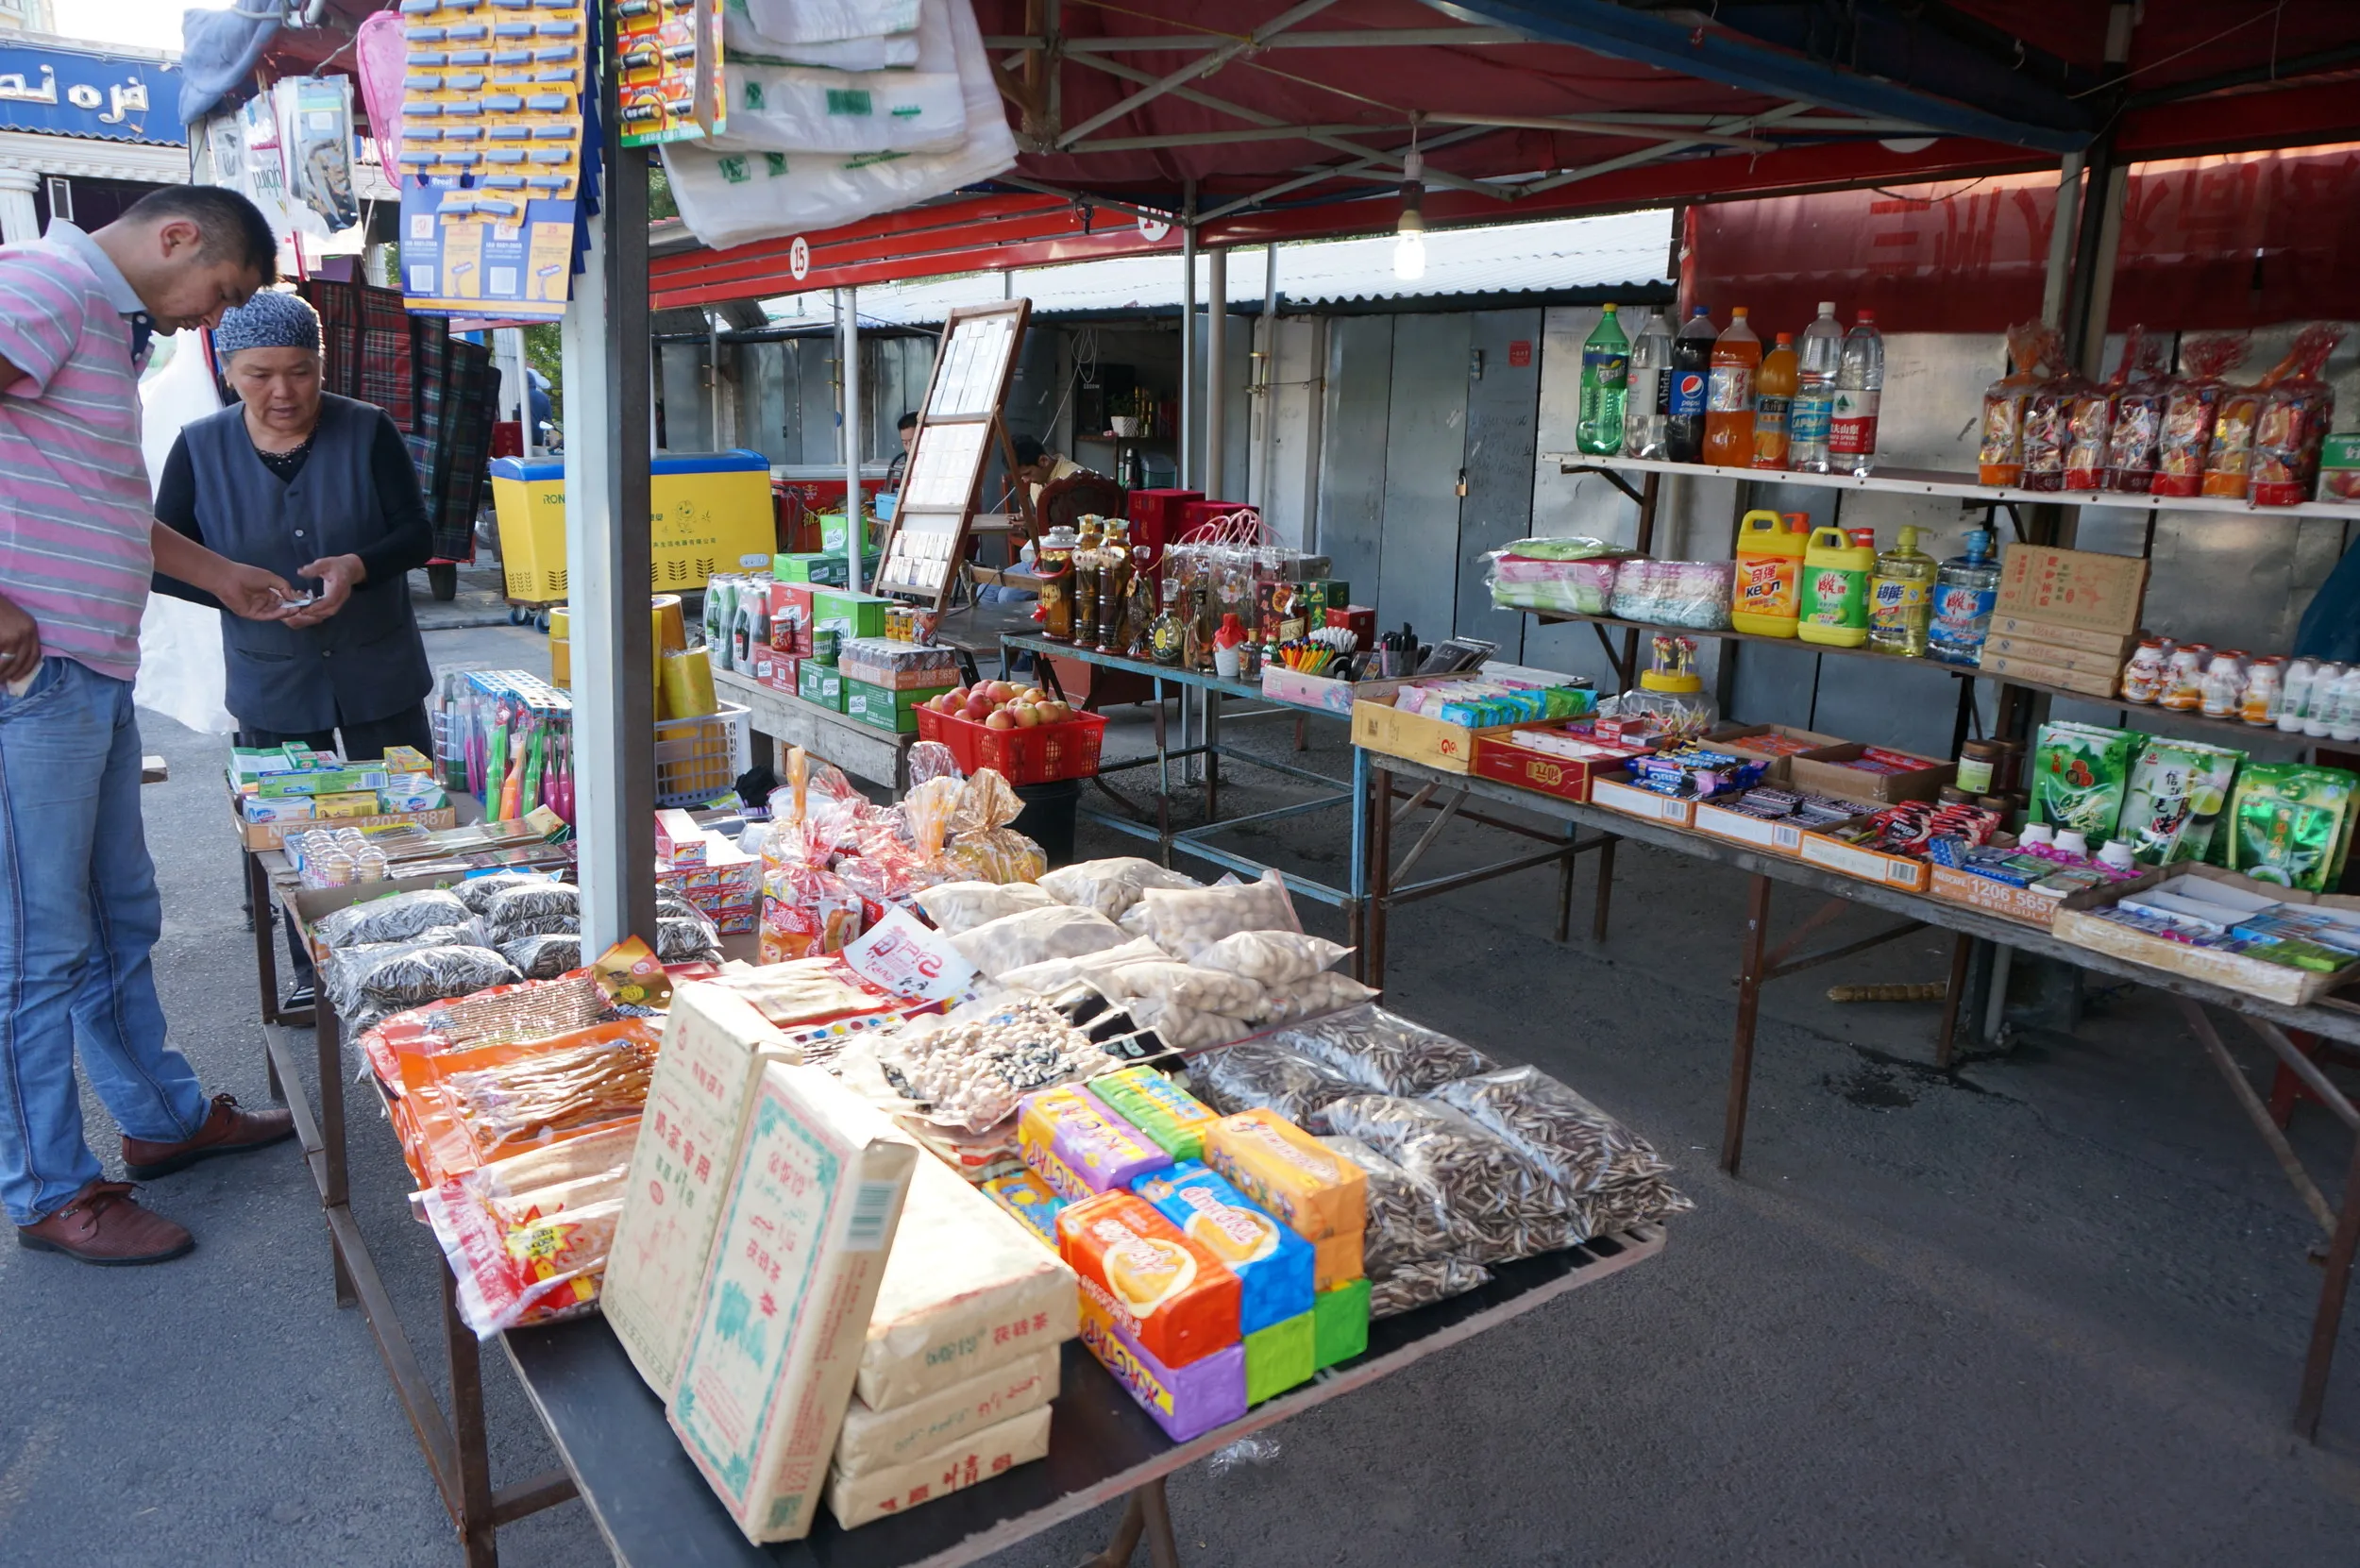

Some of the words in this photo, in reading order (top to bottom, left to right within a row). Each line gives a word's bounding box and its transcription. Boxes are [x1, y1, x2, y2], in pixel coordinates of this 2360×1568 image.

[795, 247, 804, 271] 15
[1877, 583, 1906, 601] 超能
[1649, 772, 1681, 782] OREO
[408, 809, 449, 826] 5887
[1970, 878, 2011, 902] 1206
[2015, 891, 2059, 915] 5657
